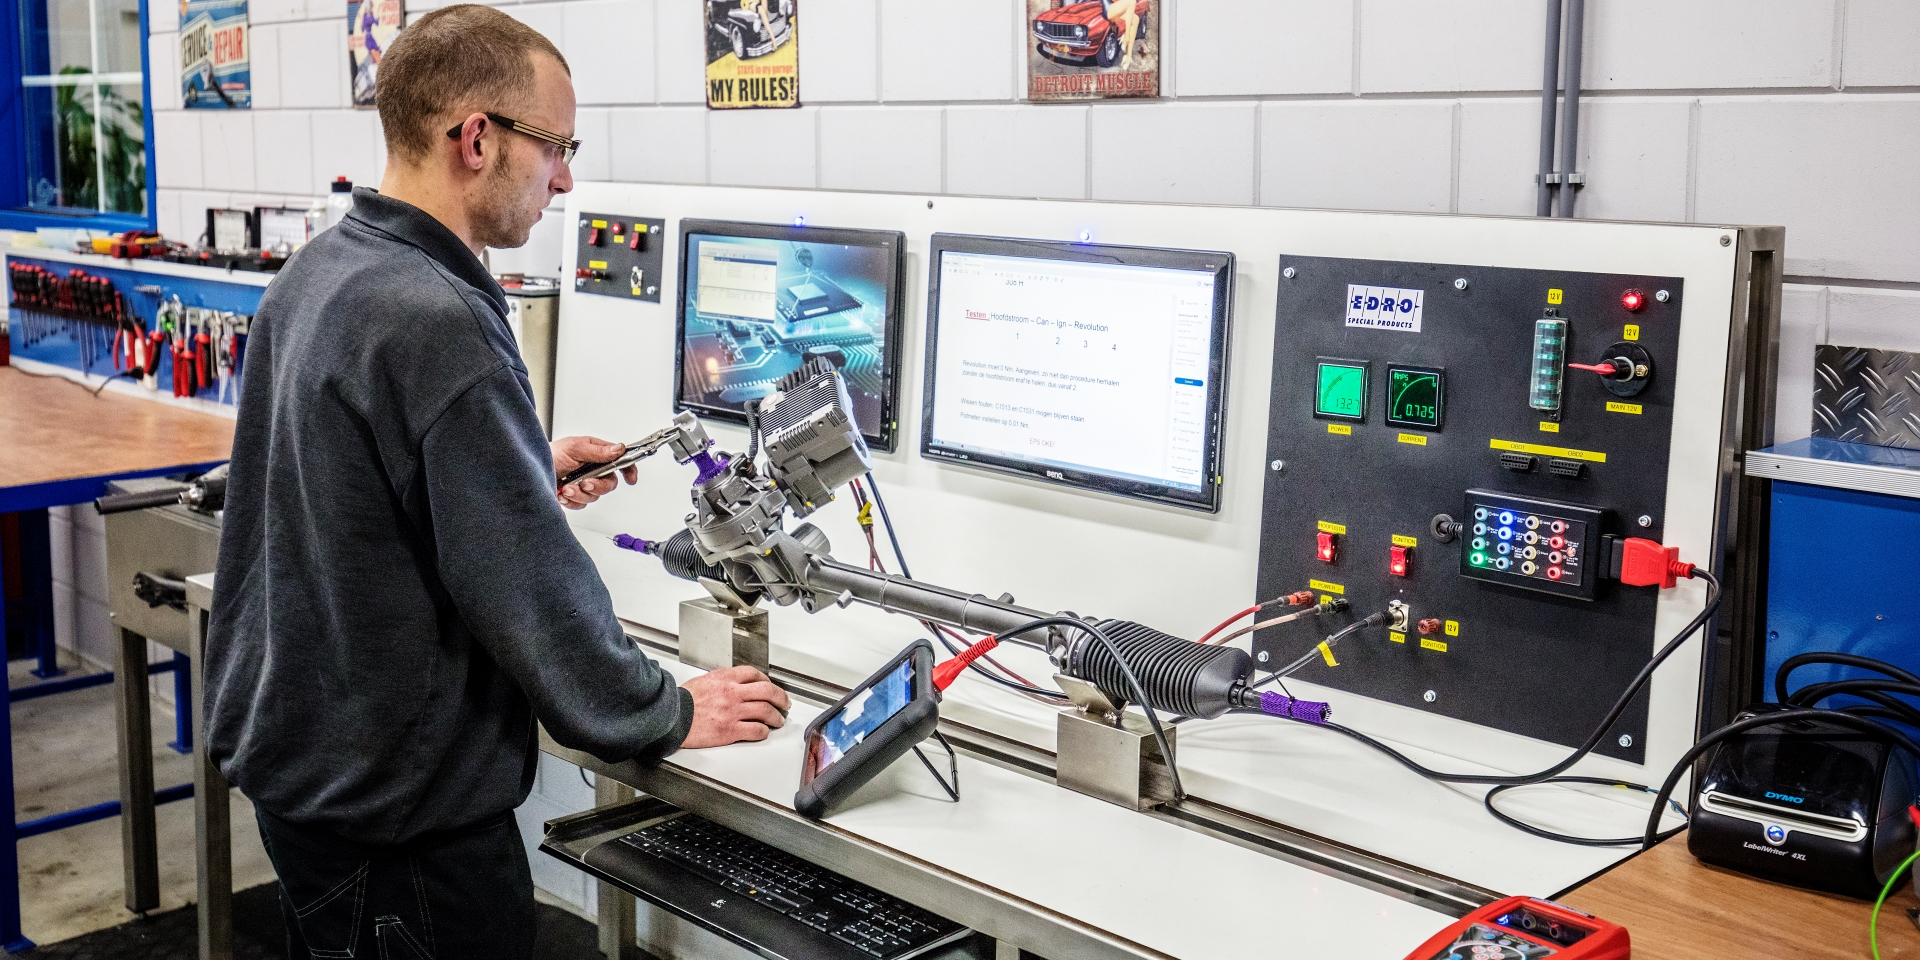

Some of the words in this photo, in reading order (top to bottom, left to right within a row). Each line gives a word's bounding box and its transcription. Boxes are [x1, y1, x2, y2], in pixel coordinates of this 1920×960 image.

[181, 23, 208, 70] SERVICE
[214, 26, 243, 66] REPAIR
[737, 65, 754, 75] STAYS
[1034, 74, 1093, 92] DETROIT
[1096, 71, 1152, 92] MUSCLE
[710, 78, 734, 102] MY
[738, 76, 794, 102] RULES!
[1352, 295, 1414, 314] EDRO
[966, 310, 986, 319] Testen
[1036, 316, 1050, 326] Can
[1056, 319, 1066, 329] Ign
[1074, 320, 1109, 332] Revolution
[1348, 317, 1374, 326] SPECIAL
[1377, 320, 1413, 329] PRODUCTS
[1056, 336, 1060, 345] 2
[1084, 340, 1088, 348] 3
[962, 360, 986, 368] Revolution
[1070, 374, 1096, 384] procedure
[1394, 372, 1408, 381] AMPS
[960, 398, 978, 406] Wissen
[1036, 410, 1052, 418] mogen
[1054, 412, 1070, 420] blijven
[1336, 398, 1360, 410] 13.27
[1030, 438, 1040, 446] EPS
[1400, 435, 1424, 444] CURRENT
[1394, 536, 1416, 545] IGNITION
[1422, 640, 1446, 650] IGNITION
[1764, 791, 1804, 804] DYMO
[1743, 841, 1788, 856] LabelWriter
[1791, 852, 1807, 861] 4XL
